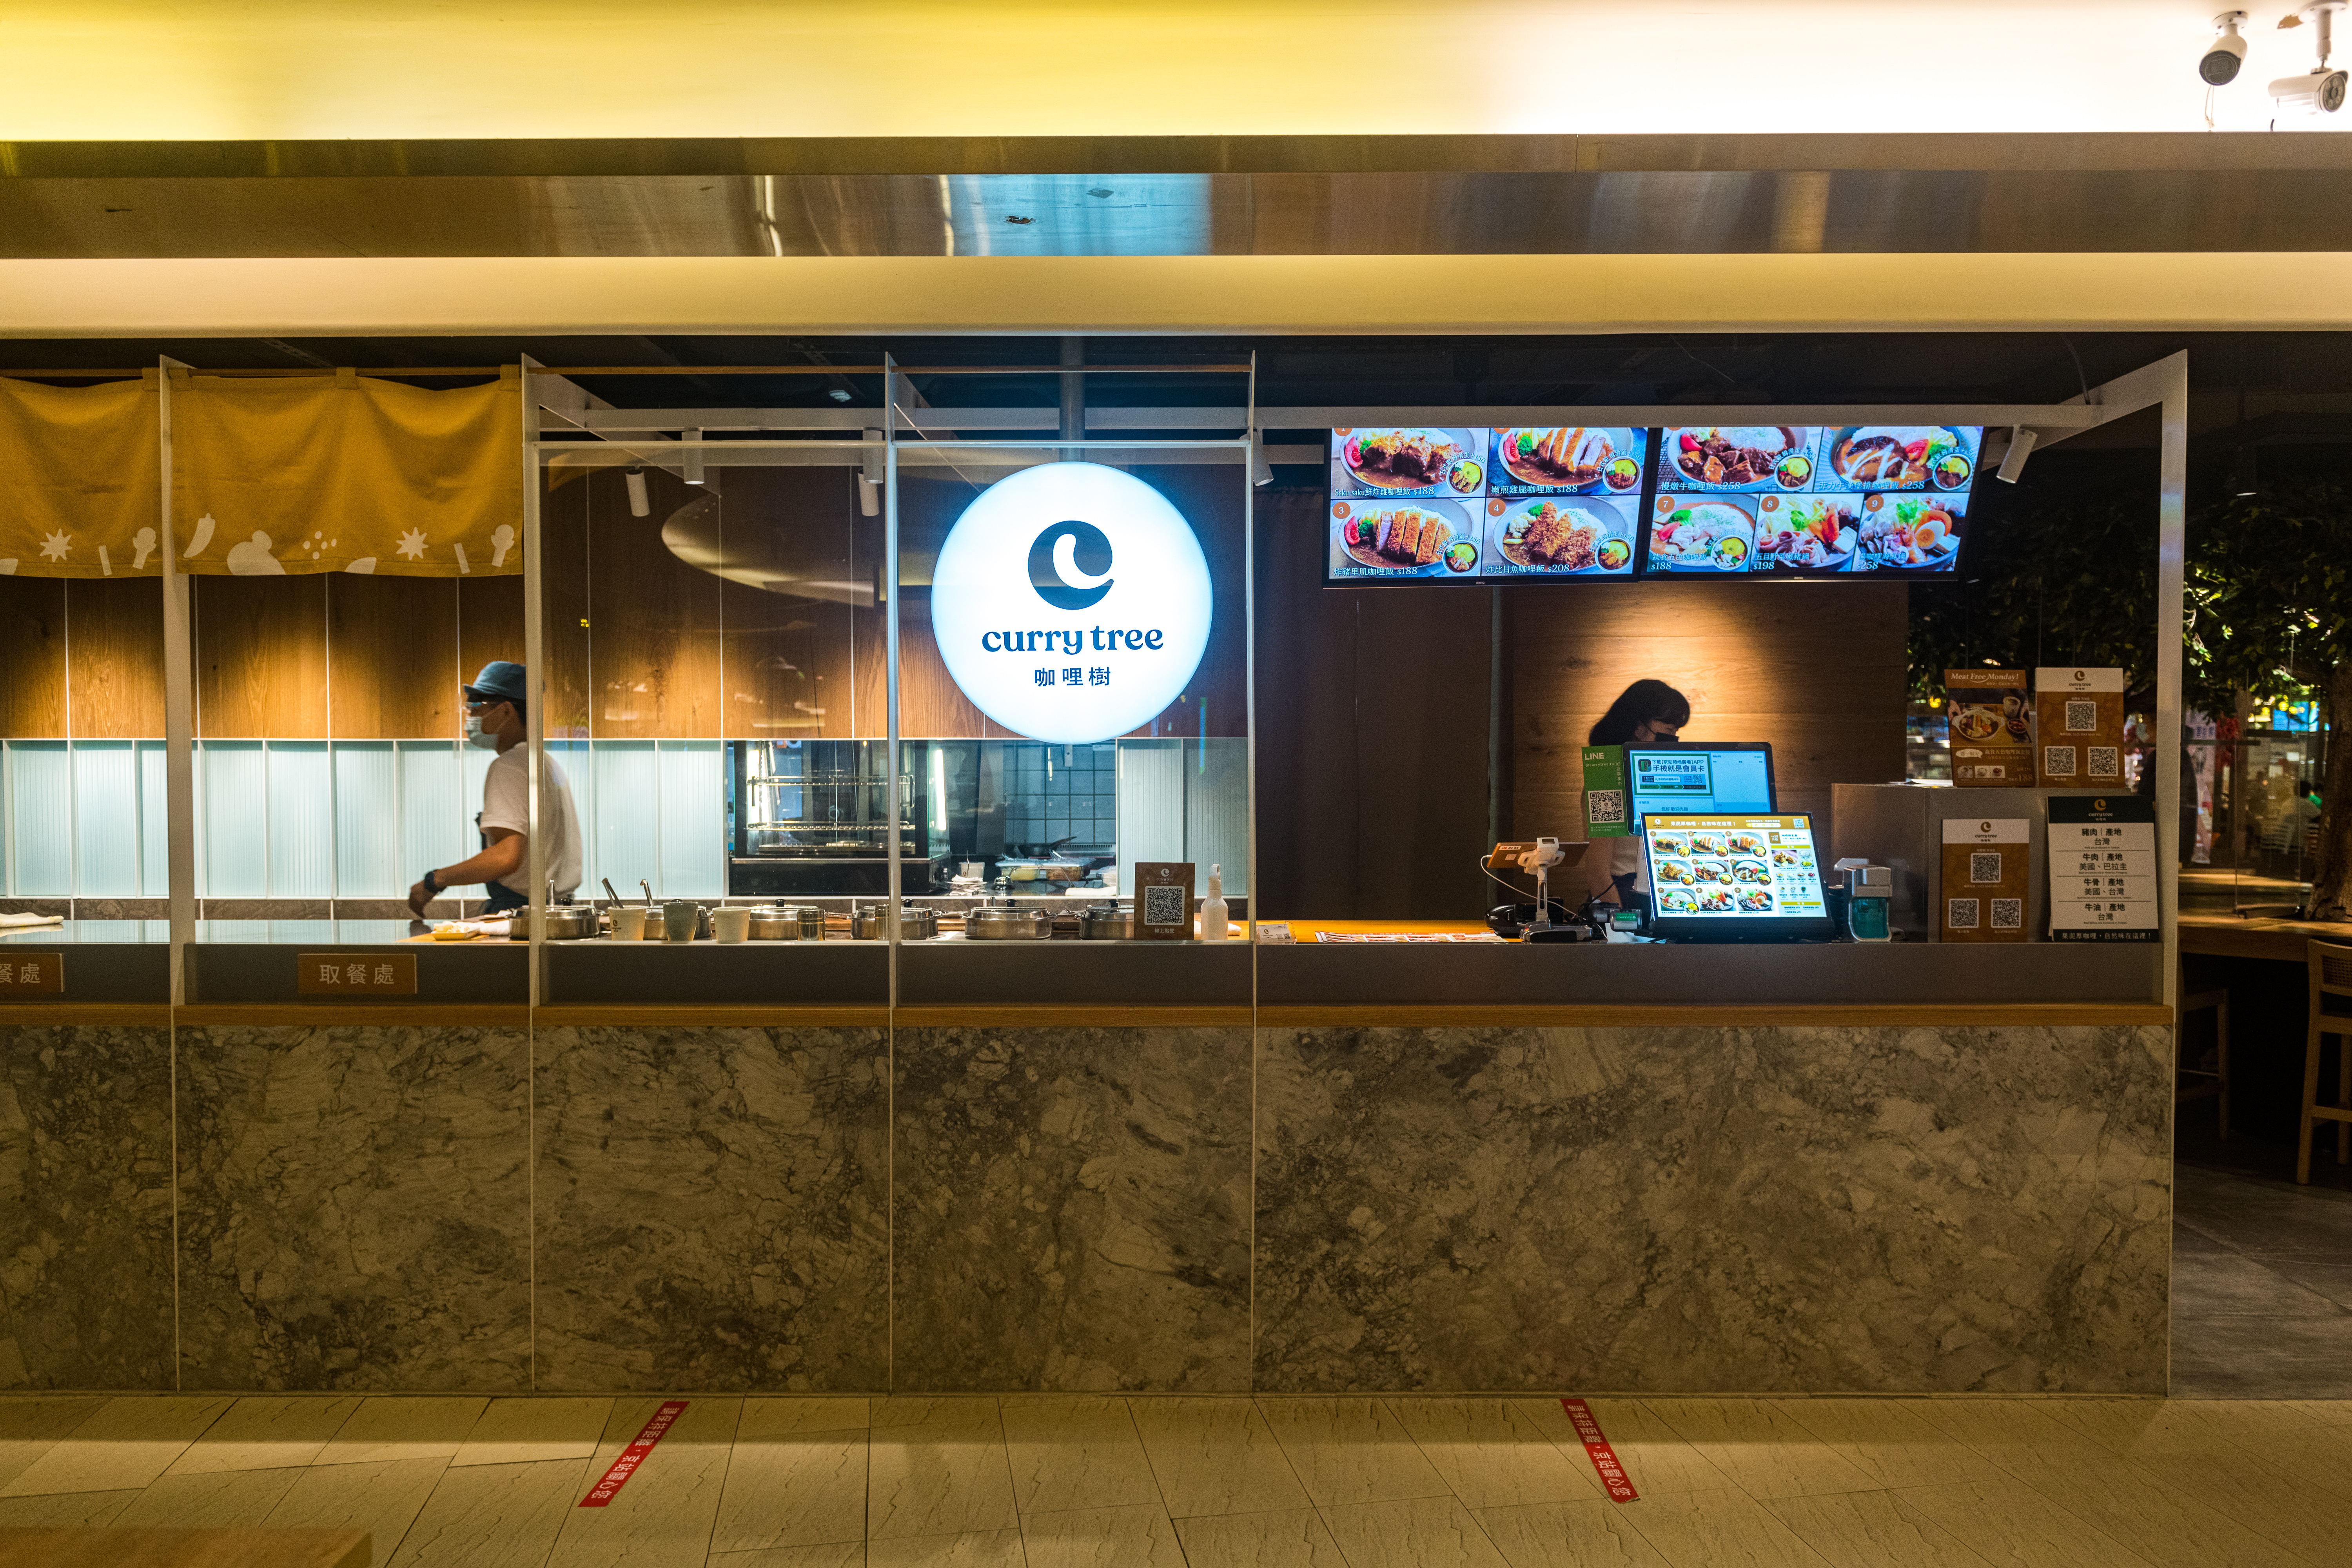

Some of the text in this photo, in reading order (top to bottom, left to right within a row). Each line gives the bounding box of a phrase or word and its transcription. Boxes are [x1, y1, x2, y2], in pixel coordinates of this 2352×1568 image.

[1491, 485, 1578, 494] 嫩煎雞腿咖哩飯 $188
[1661, 482, 1740, 490] 慢燉牛咖哩飯 $258
[1902, 481, 1925, 490] $258
[1335, 486, 1434, 496] Saku-saku鮮炸雞咖哩飯 $188
[1486, 564, 1569, 574] 炸比目魚咖哩飯 $208
[1651, 562, 1671, 570] $188
[1856, 561, 1878, 570] $258
[1334, 567, 1394, 576] 炸豬里肌咖哩飯
[982, 625, 1163, 655] curry tree
[1034, 667, 1111, 687] 咖哩樹
[1988, 673, 2019, 681] Monday!
[319, 963, 394, 984] 取餐處
[591, 1407, 680, 1499] 請保持距離，京站關心您
[1567, 1405, 1631, 1495] 請保持距離，京站關心您
